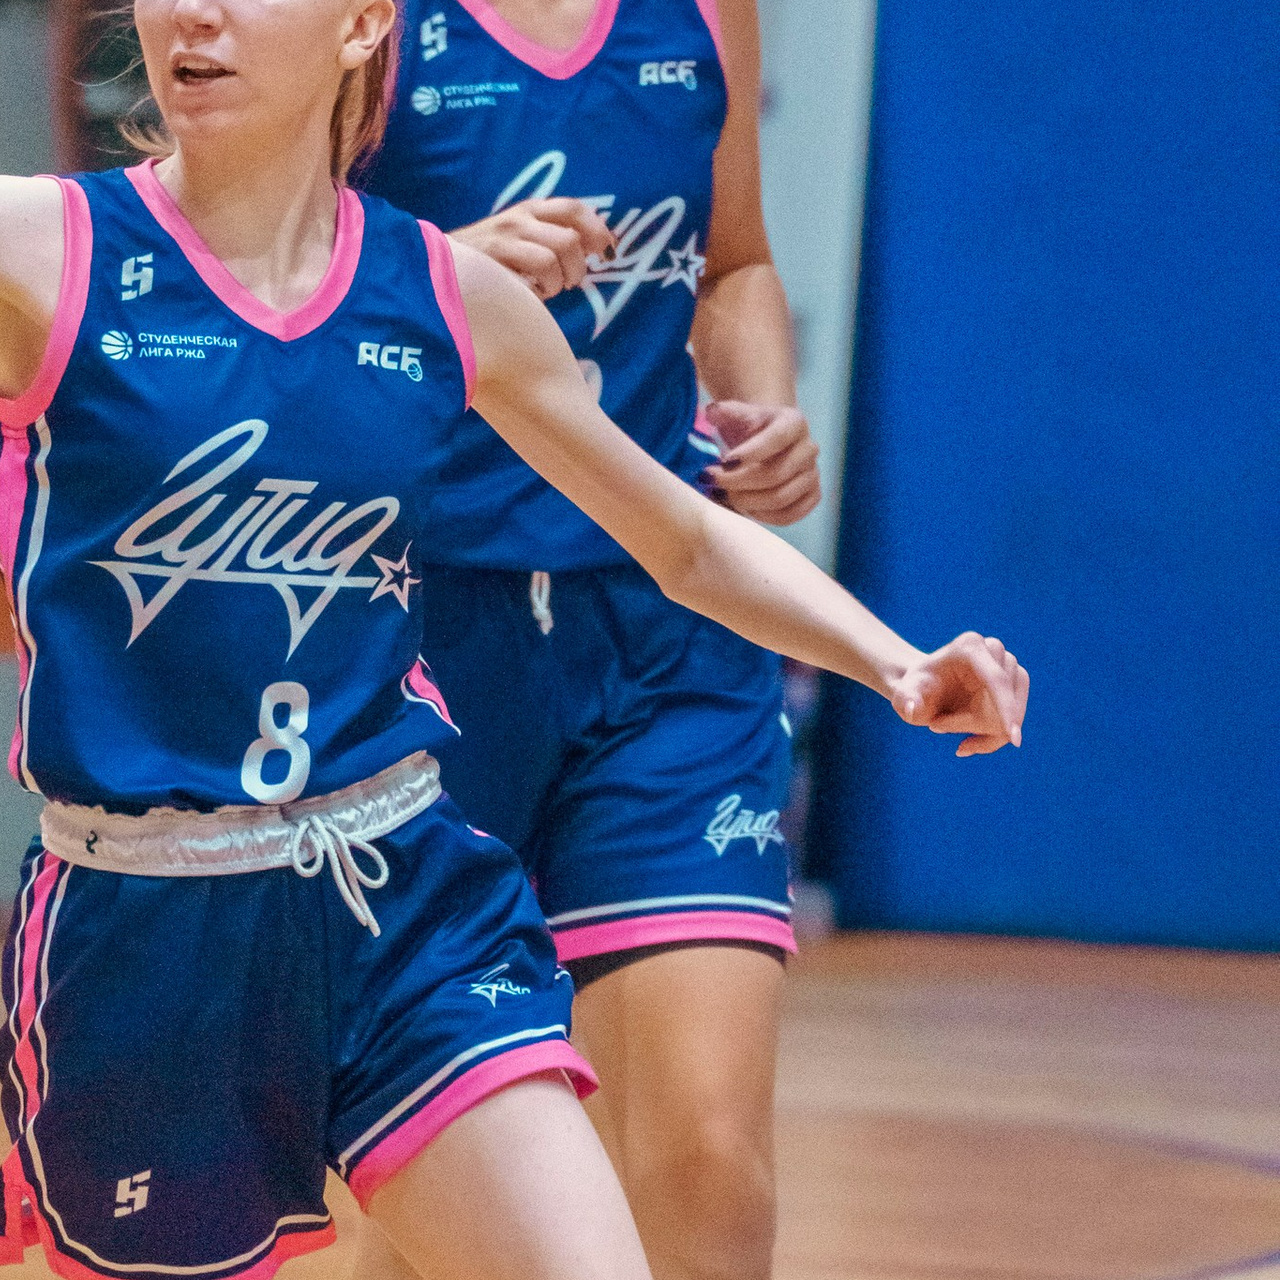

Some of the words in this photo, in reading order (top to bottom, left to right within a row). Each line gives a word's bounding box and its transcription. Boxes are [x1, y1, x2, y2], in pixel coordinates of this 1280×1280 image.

[138, 332, 238, 348] СТУДЕНЧЕСКАЯ
[139, 347, 174, 358] ЛИГА
[176, 347, 206, 359] РЖД
[357, 341, 423, 382] АСБ
[241, 680, 311, 804] 8
